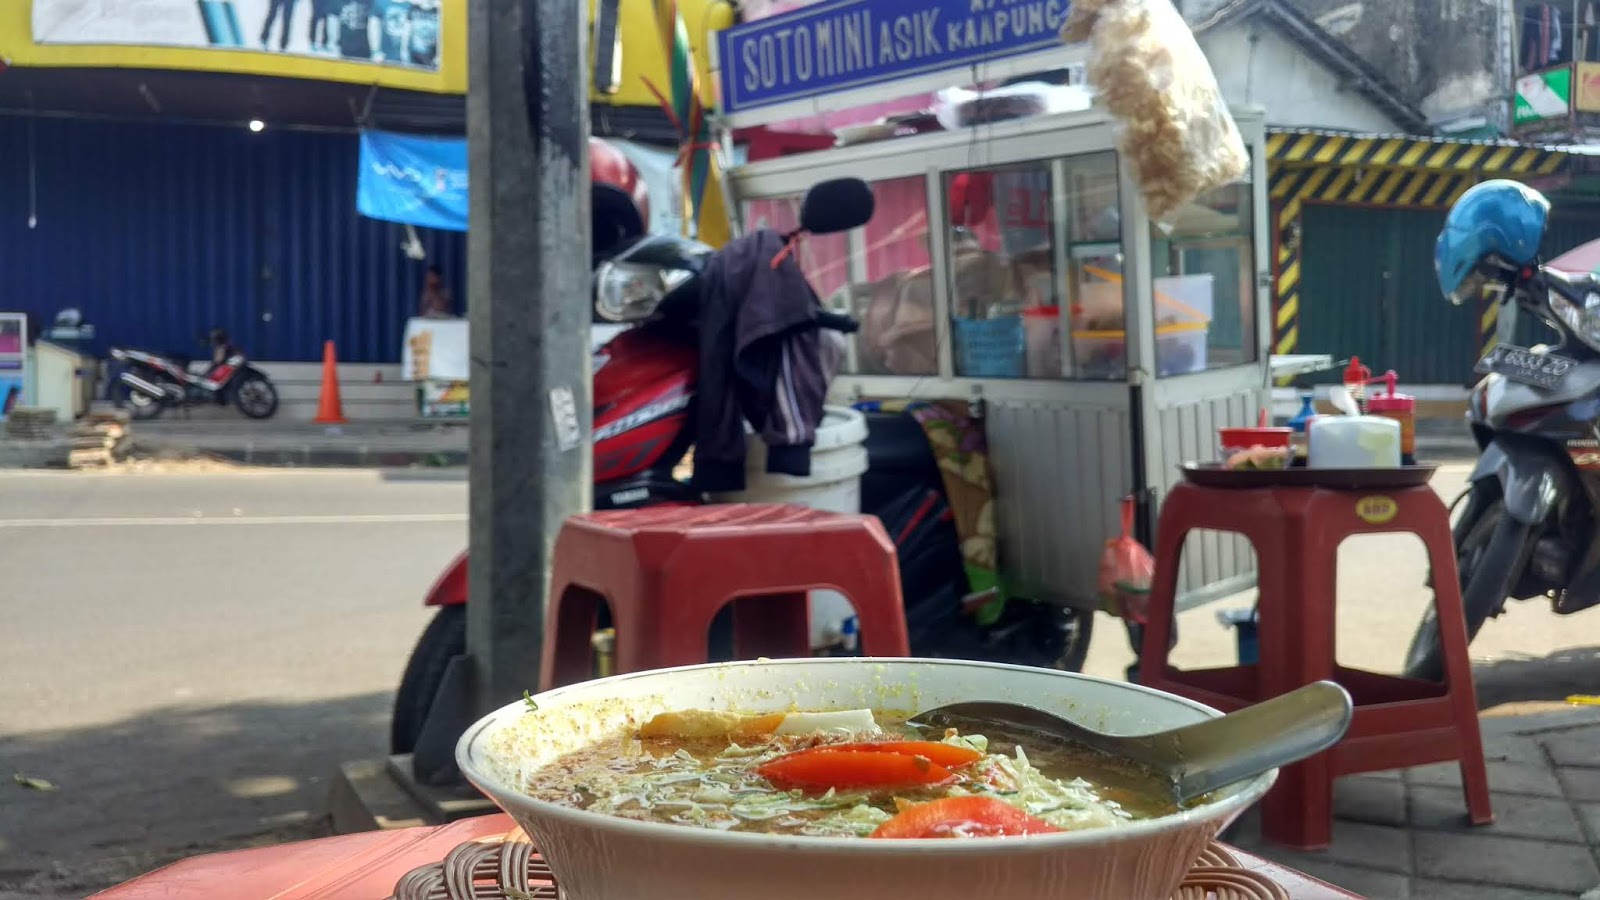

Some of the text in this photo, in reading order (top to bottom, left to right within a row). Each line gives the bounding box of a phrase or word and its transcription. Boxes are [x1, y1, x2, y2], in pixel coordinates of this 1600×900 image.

[743, 26, 813, 92] SOTO
[815, 9, 874, 77] MINI
[879, 8, 943, 64] ASIK
